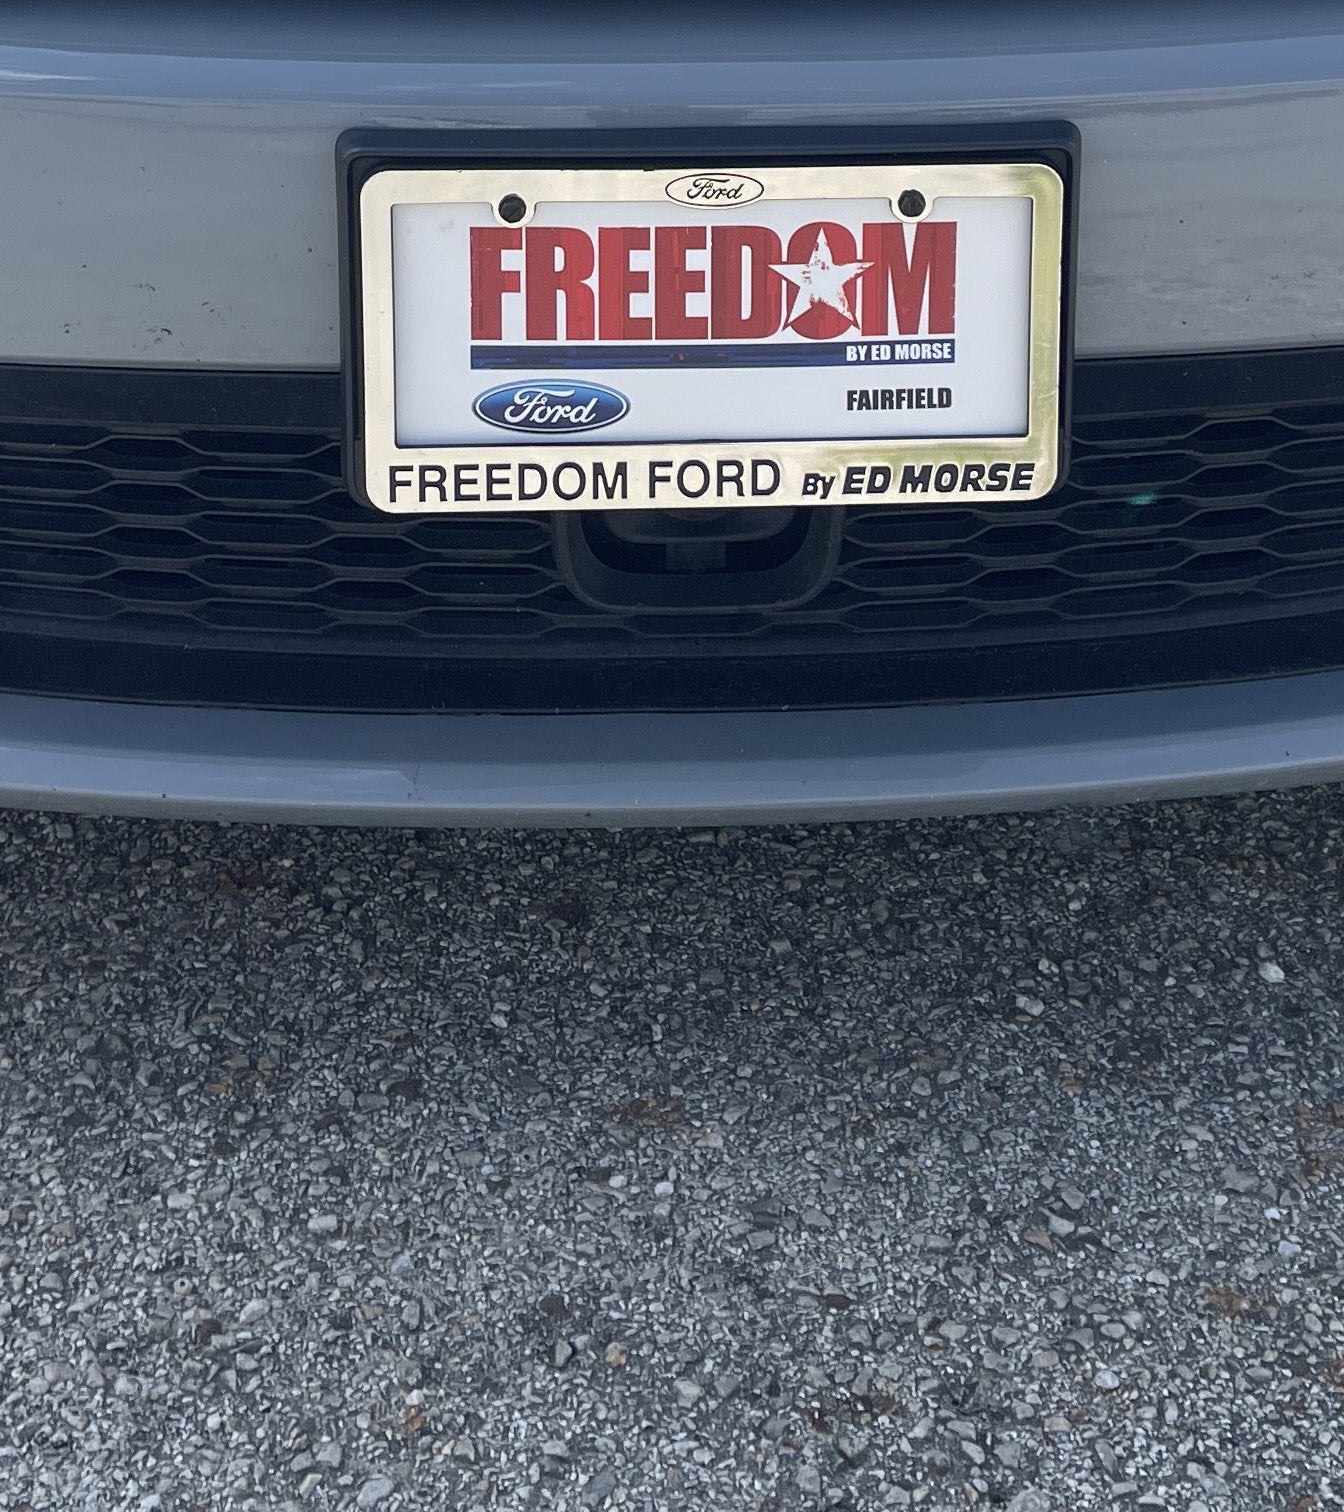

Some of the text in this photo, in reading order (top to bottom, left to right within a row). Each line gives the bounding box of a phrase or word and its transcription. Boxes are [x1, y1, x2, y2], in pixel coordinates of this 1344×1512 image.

[686, 177, 744, 200] Ford
[469, 220, 958, 341] FREEDOM
[846, 342, 952, 362] BY ED MORSE
[504, 387, 597, 424] Ford
[846, 387, 952, 411] FAIRFIELD
[388, 458, 1036, 503] FREEDOM FORD By ED MORSE
